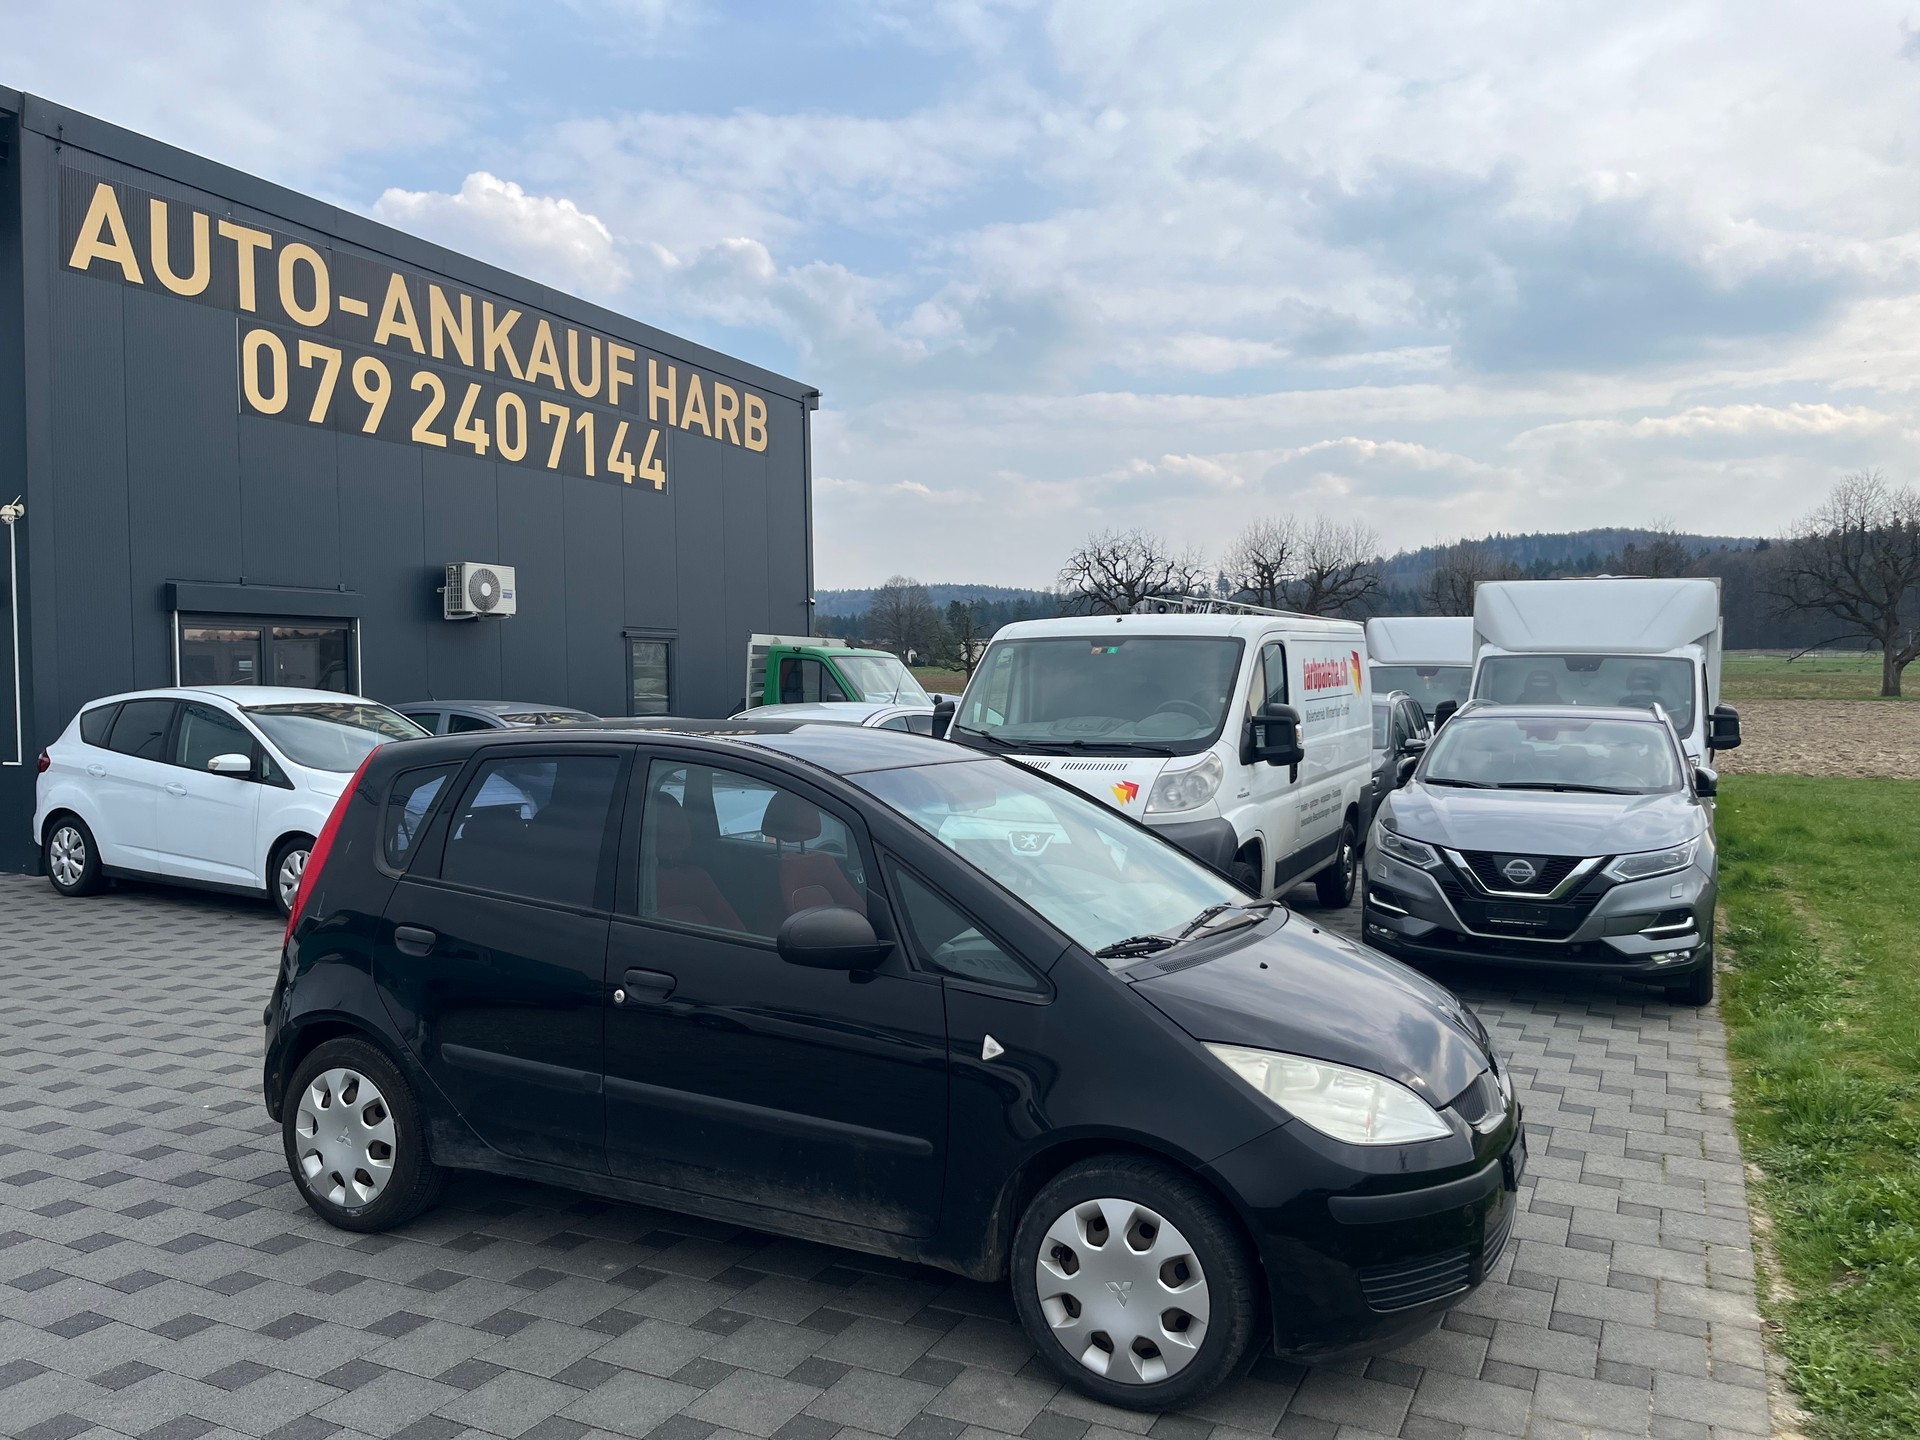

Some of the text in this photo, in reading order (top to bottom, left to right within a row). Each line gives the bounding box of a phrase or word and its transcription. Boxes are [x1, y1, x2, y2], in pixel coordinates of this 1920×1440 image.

[69, 183, 768, 452] AUTO-ANKAUF HARB
[243, 328, 392, 433] 079
[411, 371, 528, 462] 240
